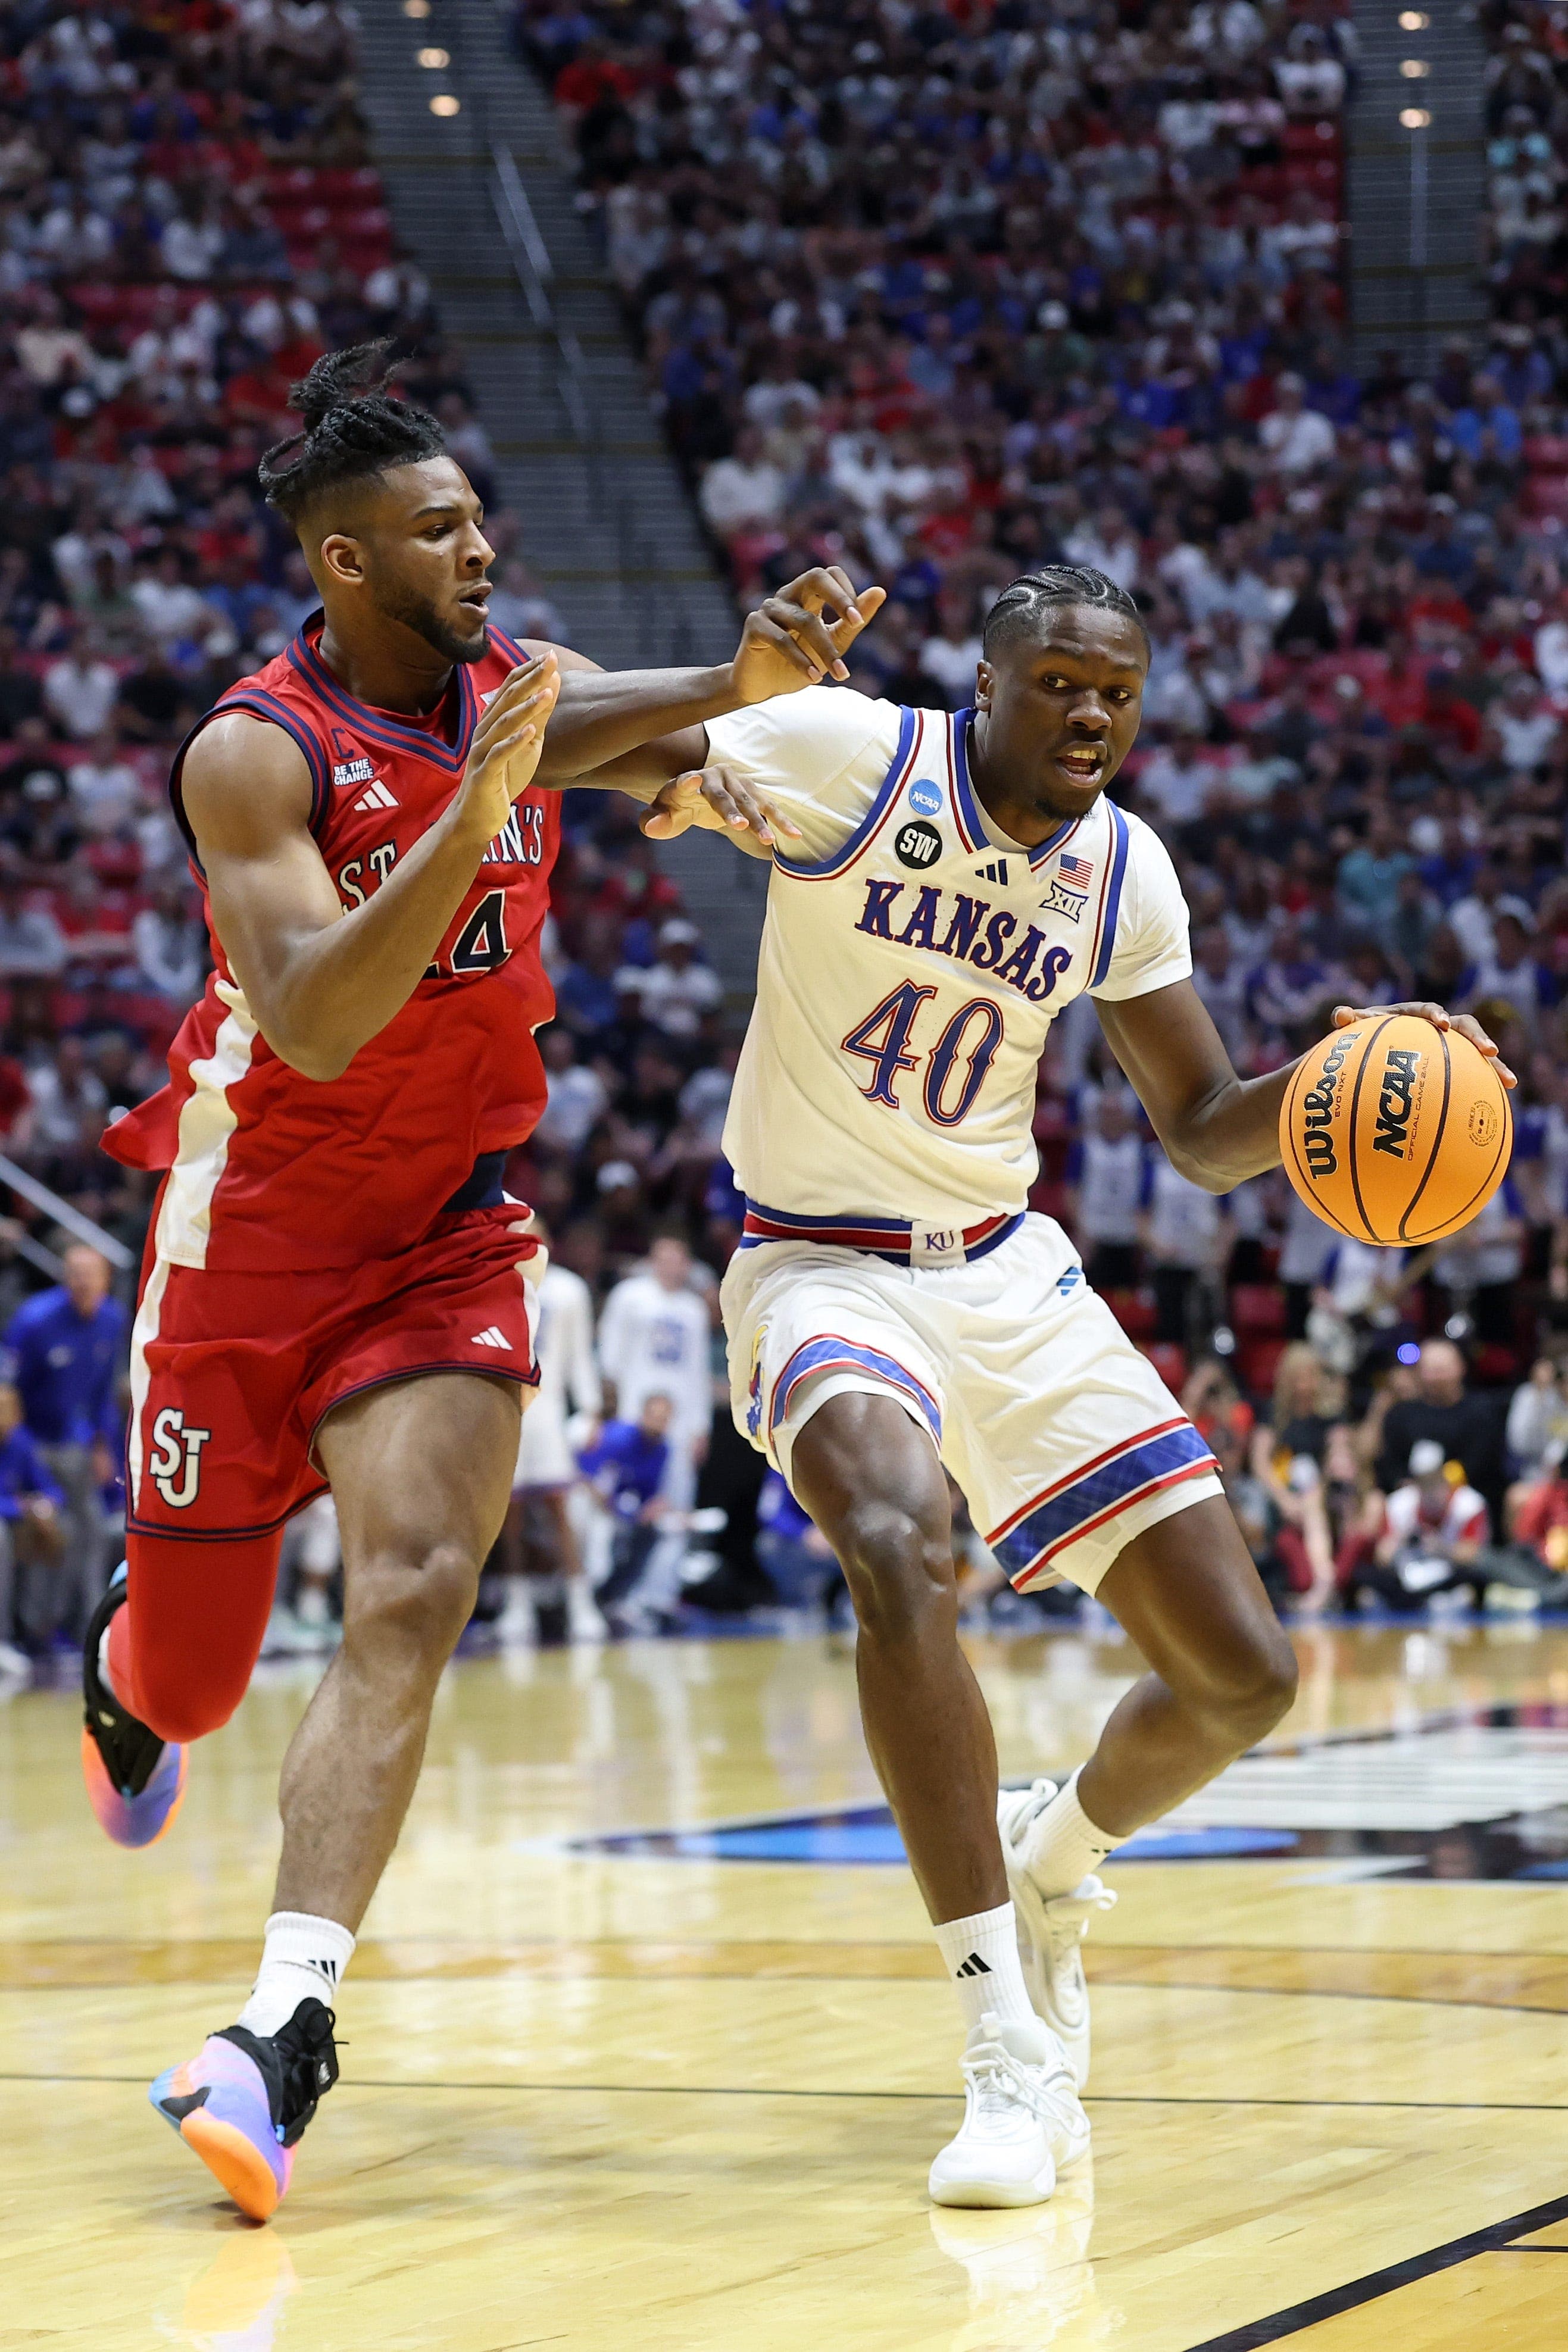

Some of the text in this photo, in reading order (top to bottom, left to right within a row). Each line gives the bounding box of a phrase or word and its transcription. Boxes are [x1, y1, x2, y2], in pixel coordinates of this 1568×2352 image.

[334, 758, 369, 776] BE THE
[334, 768, 374, 785] CHANGE
[911, 791, 939, 811] NCAA
[899, 828, 938, 863] SW
[1038, 880, 1089, 924] XII
[421, 889, 513, 979] 4
[854, 878, 1073, 1001] KANSAS
[840, 977, 1004, 1127] 40
[1338, 1071, 1348, 1092] NXT
[1302, 1032, 1363, 1180] Wilson
[1372, 1050, 1422, 1159] NCAA
[1408, 1057, 1429, 1161] OFFICIAL GAME BALL
[924, 1230, 954, 1251] KU
